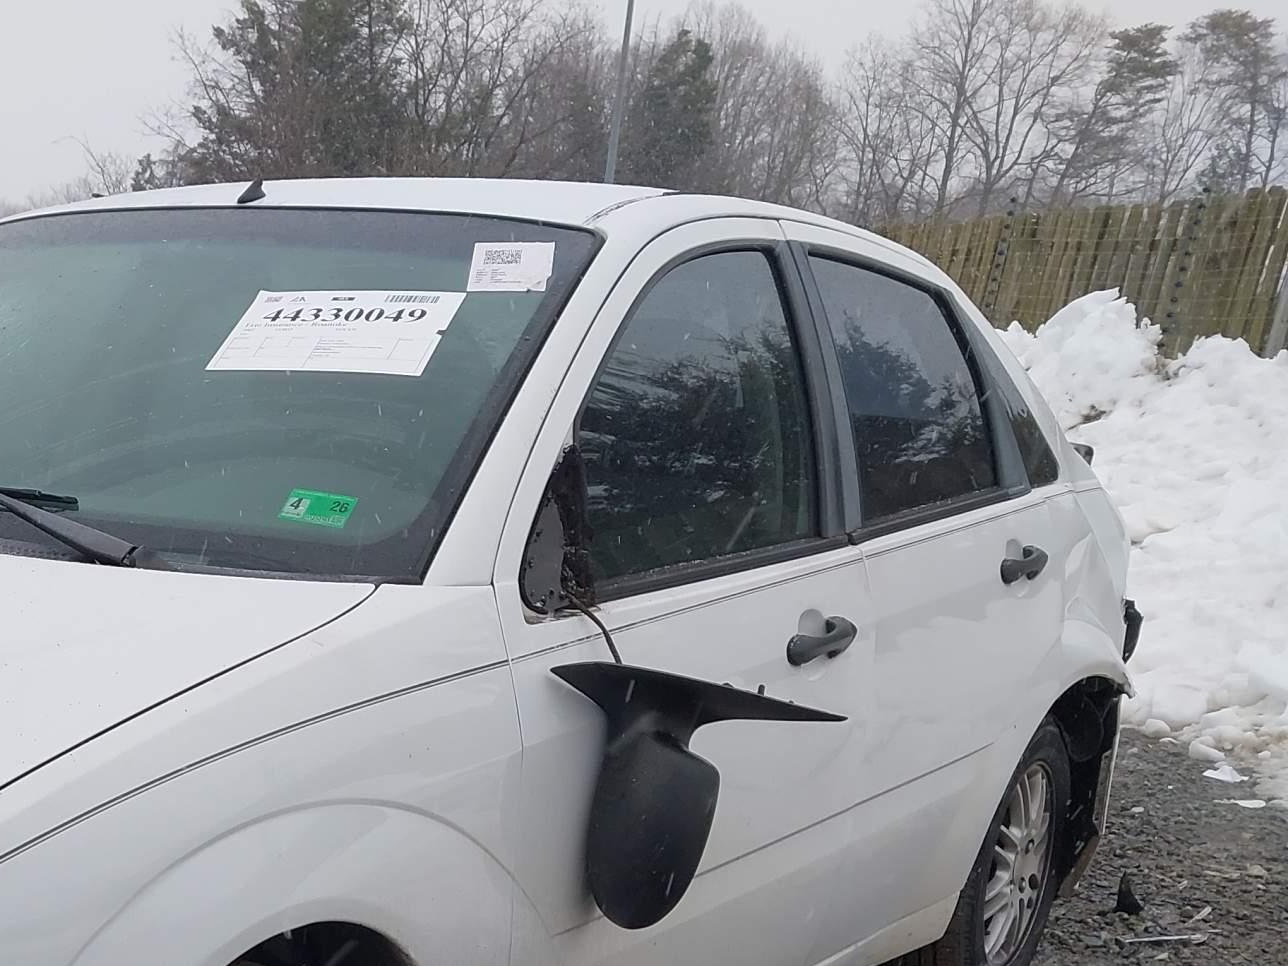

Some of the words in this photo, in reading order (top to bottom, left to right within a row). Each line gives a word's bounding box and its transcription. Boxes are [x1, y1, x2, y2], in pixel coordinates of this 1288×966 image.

[263, 307, 427, 322] 44330049
[289, 497, 304, 510] 4
[328, 500, 350, 513] 26
